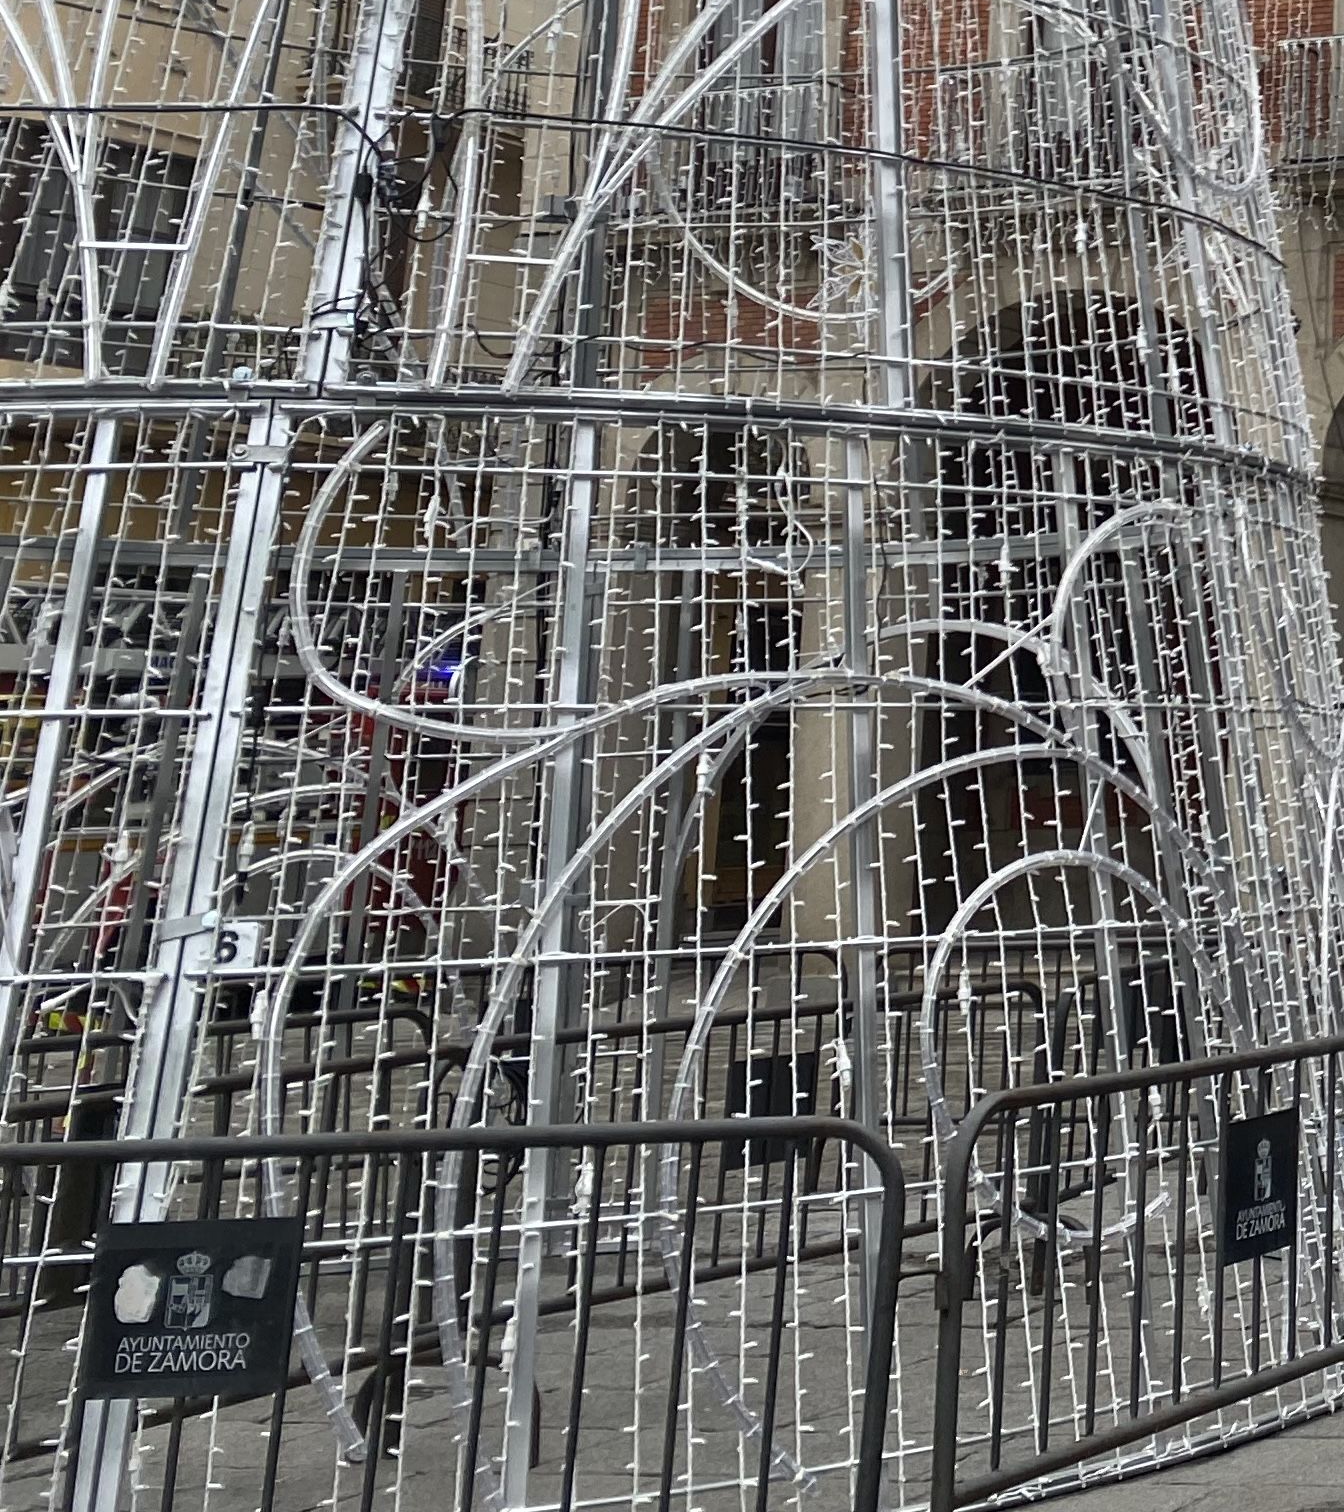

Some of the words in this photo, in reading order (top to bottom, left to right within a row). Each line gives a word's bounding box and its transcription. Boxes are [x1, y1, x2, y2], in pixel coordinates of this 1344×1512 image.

[1236, 1223, 1248, 1241] DE
[1249, 1213, 1286, 1237] ZAMORA
[118, 1332, 250, 1352] AYUNTAMIENTO
[114, 1353, 142, 1374] DE
[147, 1350, 247, 1373] ZAMORA
